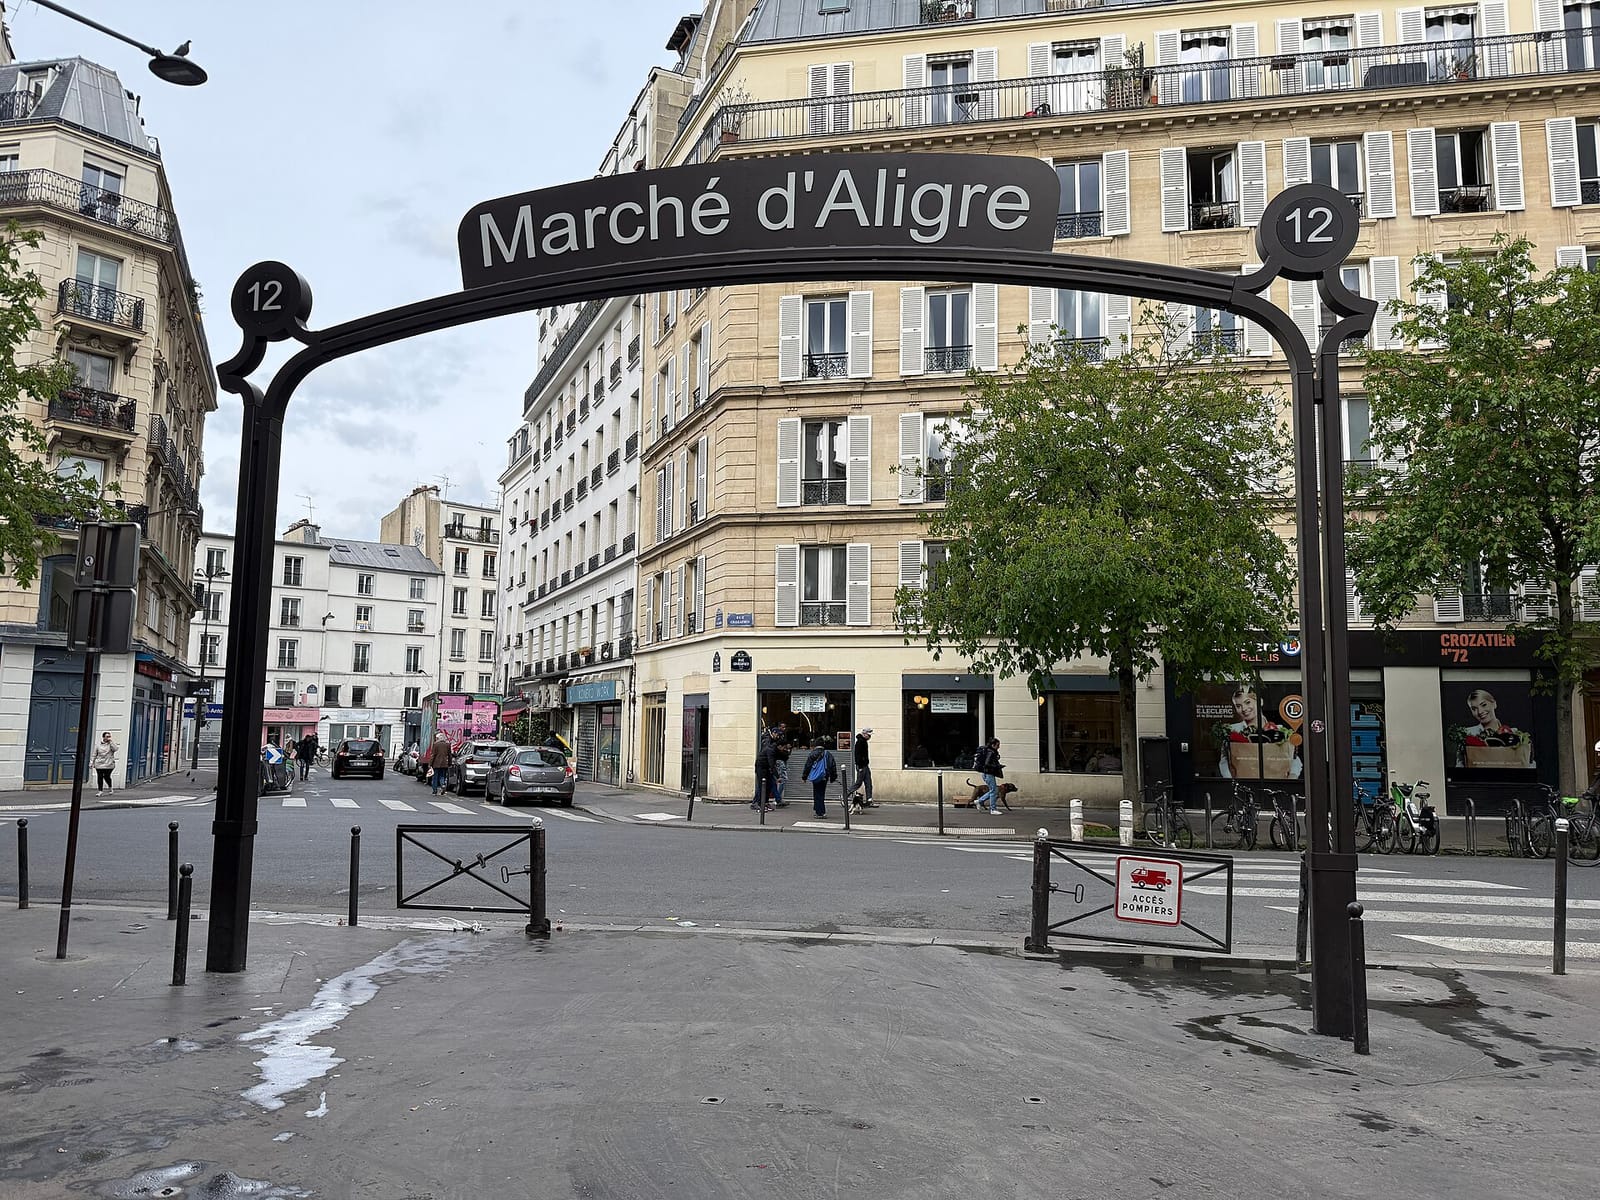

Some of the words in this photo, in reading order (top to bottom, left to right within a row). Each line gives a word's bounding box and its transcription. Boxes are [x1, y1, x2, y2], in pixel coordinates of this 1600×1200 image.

[479, 176, 730, 268] Marché
[757, 168, 1031, 244] d'Aligre
[1285, 206, 1334, 243] 12
[247, 280, 283, 312] 12
[1440, 633, 1516, 647] CROZATIER
[1122, 902, 1173, 916] POMPIERS
[1132, 894, 1164, 905] ACCÈS
